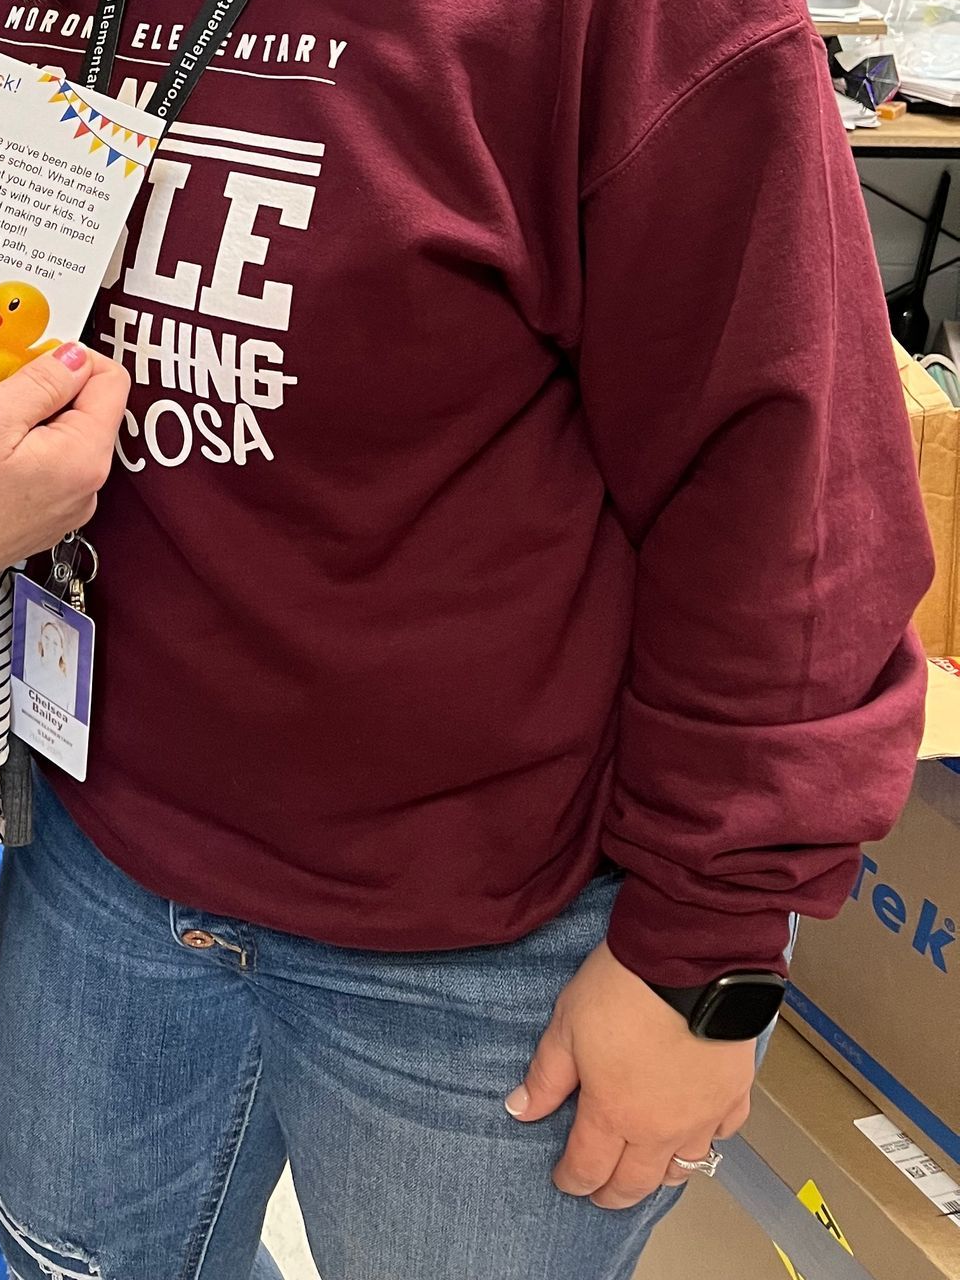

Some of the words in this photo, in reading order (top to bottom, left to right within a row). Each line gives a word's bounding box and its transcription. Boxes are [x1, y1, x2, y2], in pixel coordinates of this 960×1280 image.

[4, 5, 94, 39] MORON
[131, 23, 348, 69] ELEENTARY
[157, 70, 188, 118] oroni
[5, 139, 40, 159] you've
[41, 151, 68, 169] been
[69, 163, 93, 179] able
[94, 171, 105, 183] to
[7, 155, 43, 177] school.
[46, 169, 75, 188] What
[76, 182, 111, 201] makes
[5, 173, 27, 188] you
[28, 179, 54, 197] have
[56, 189, 86, 209] found
[87, 203, 95, 213] a
[10, 189, 31, 205] with
[32, 199, 52, 212] our
[52, 204, 75, 222] kids.
[80, 214, 100, 230] You
[4, 205, 43, 227] making
[44, 220, 58, 231] an
[59, 223, 95, 245] impact
[2, 237, 28, 255] path,
[31, 249, 45, 260] go
[47, 252, 87, 274] instead
[24, 263, 33, 272] a
[104, 303, 290, 410] THING
[115, 398, 275, 473] COSA
[28, 689, 68, 723] Chelsea
[32, 701, 63, 731] Bailey
